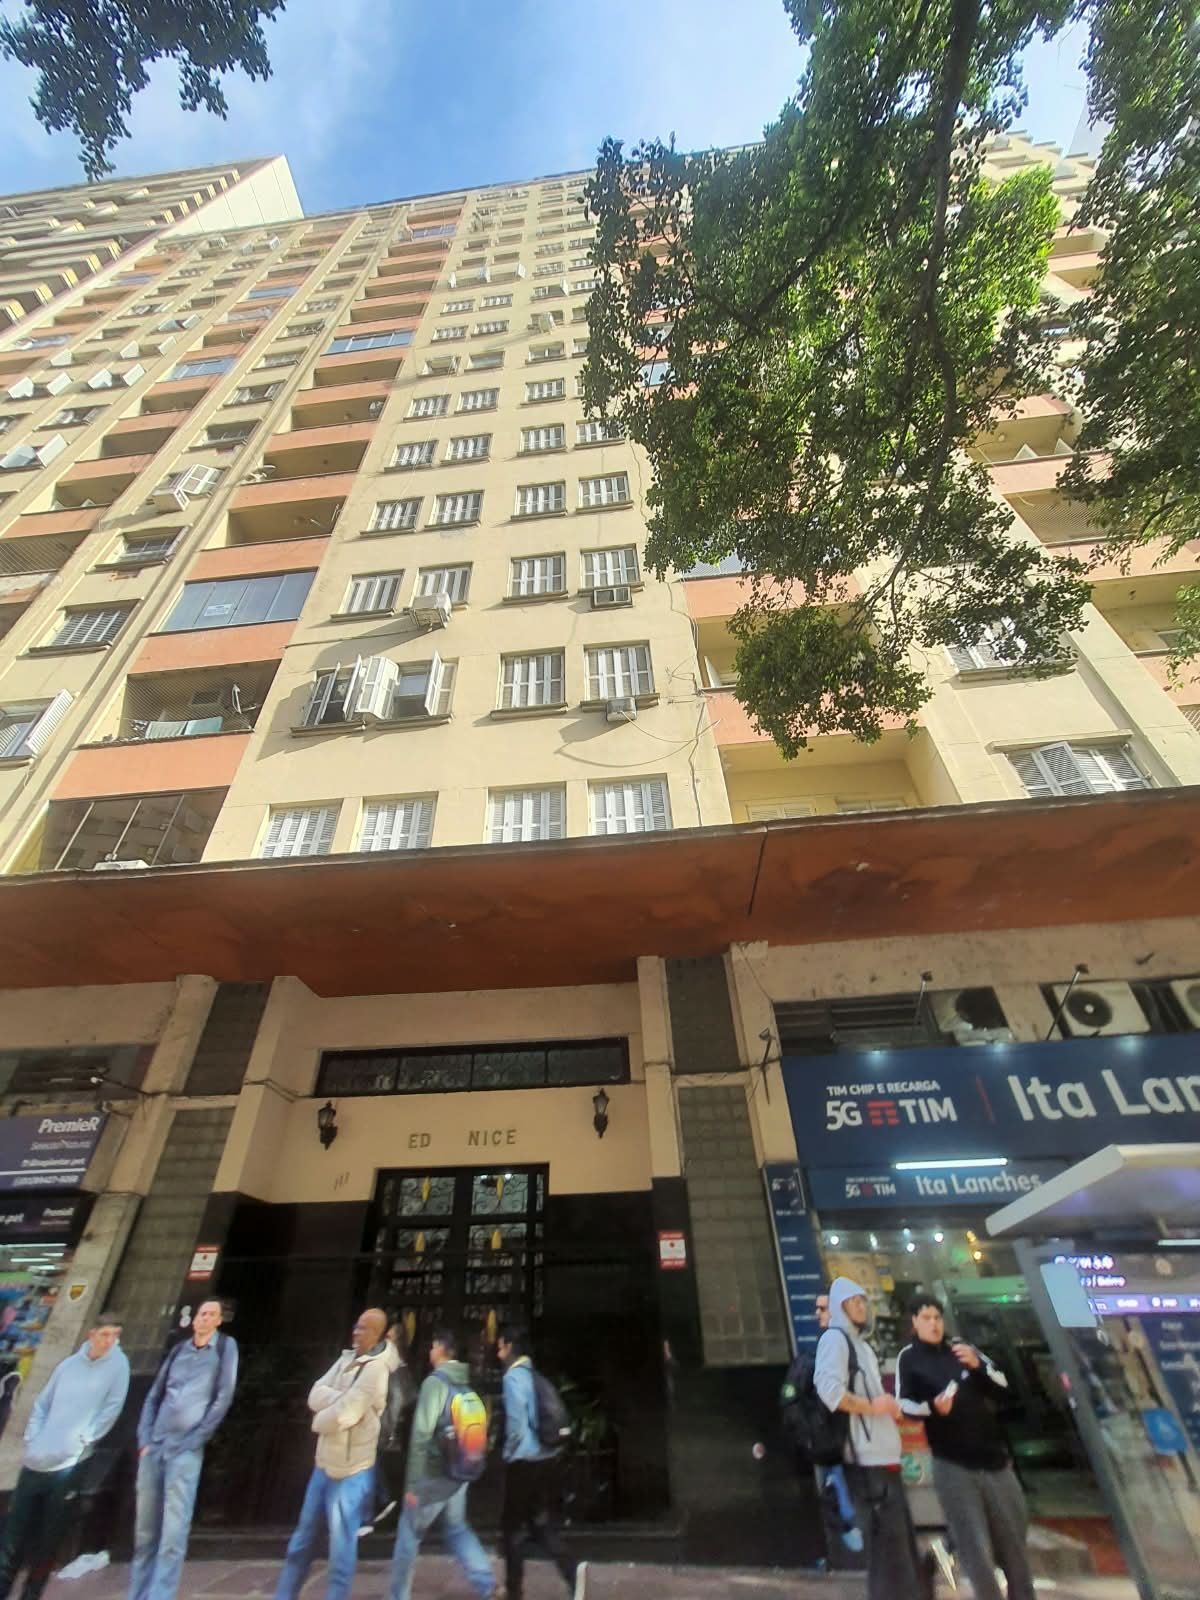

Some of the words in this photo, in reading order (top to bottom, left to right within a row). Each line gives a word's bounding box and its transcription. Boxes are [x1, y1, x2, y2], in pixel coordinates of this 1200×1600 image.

[826, 1085, 848, 1097] TIM
[849, 1082, 875, 1096] CHIP
[876, 1082, 886, 1094] E
[886, 1079, 940, 1094] RECARGA
[1007, 1075, 1098, 1121] Ita
[825, 1100, 863, 1131] 5G
[898, 1096, 958, 1124] TIM
[407, 1132, 432, 1149] ED
[467, 1128, 517, 1147] NICE
[873, 1183, 897, 1197] TIM
[914, 1174, 948, 1197] Ita
[950, 1171, 1042, 1195] Lanches
